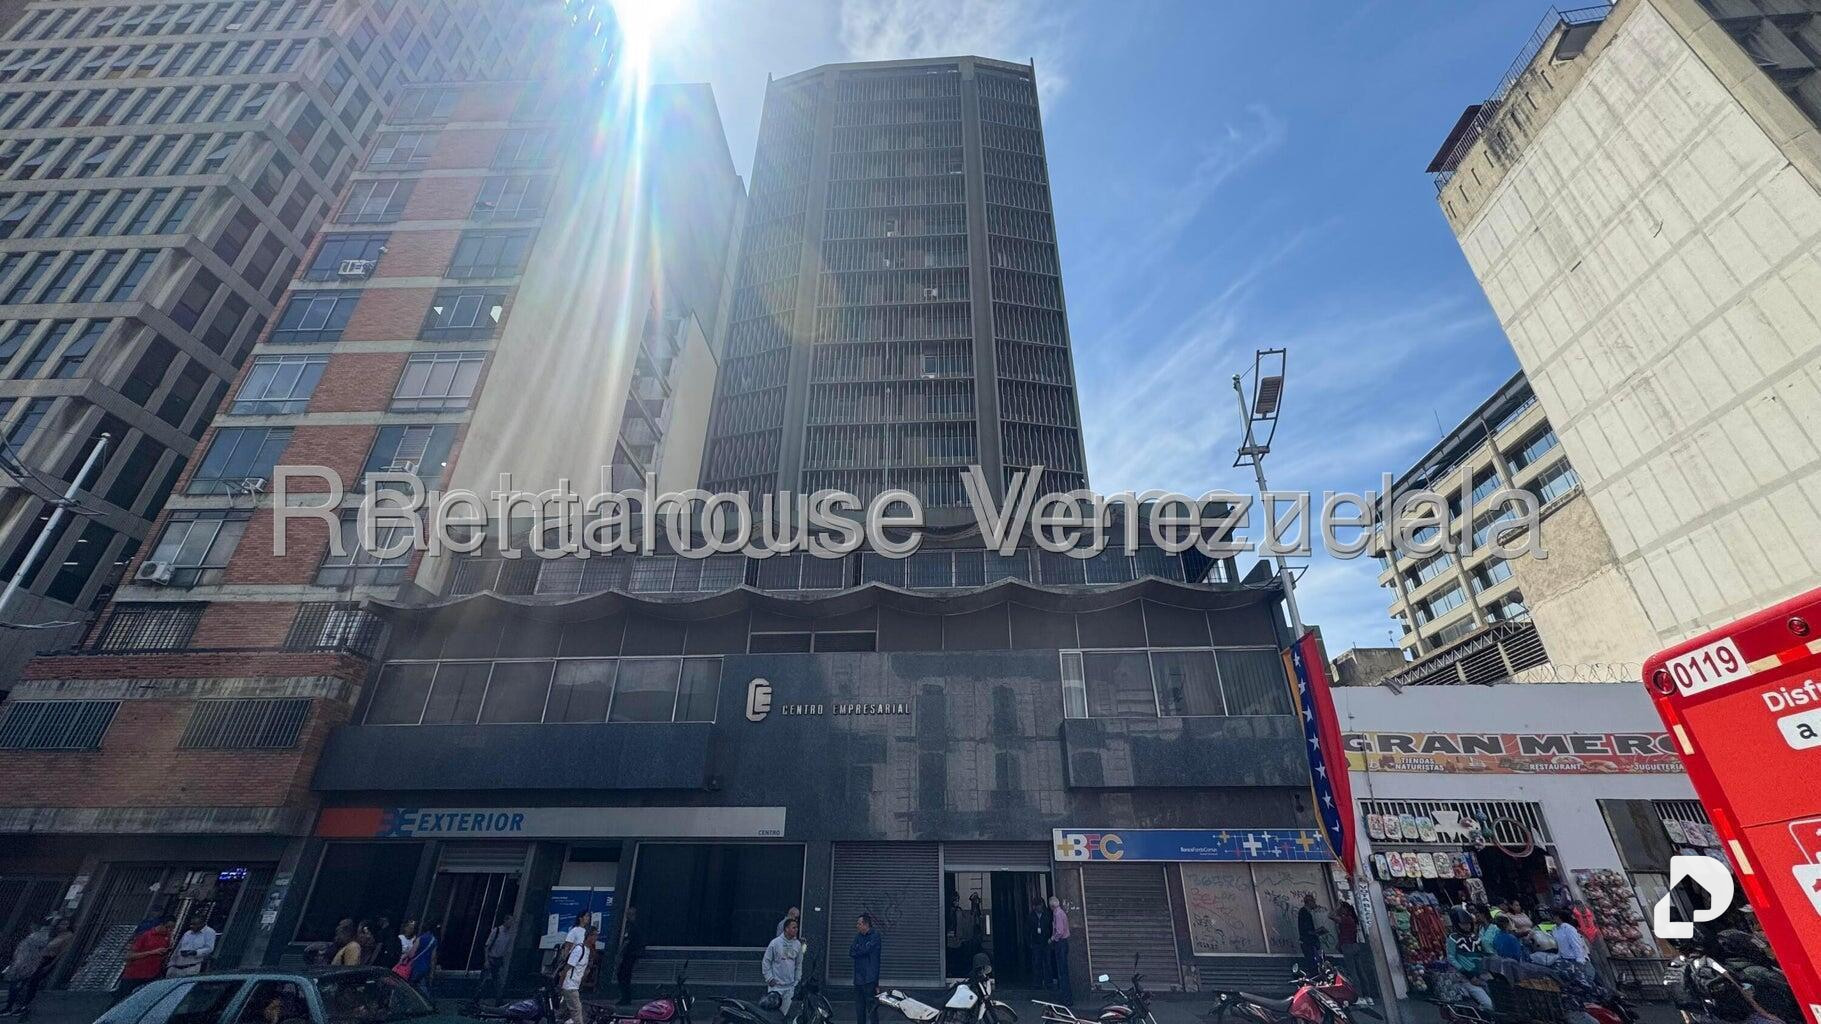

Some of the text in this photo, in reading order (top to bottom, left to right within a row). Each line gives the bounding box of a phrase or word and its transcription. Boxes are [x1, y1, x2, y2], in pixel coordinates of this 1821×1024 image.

[1673, 645, 1739, 689] 0119
[782, 703, 911, 716] CENTRO EMPRESARIAL
[1342, 733, 1505, 755] GRAN
[1529, 763, 1582, 771] RESTAURANT
[417, 812, 525, 833] EXTERIOR
